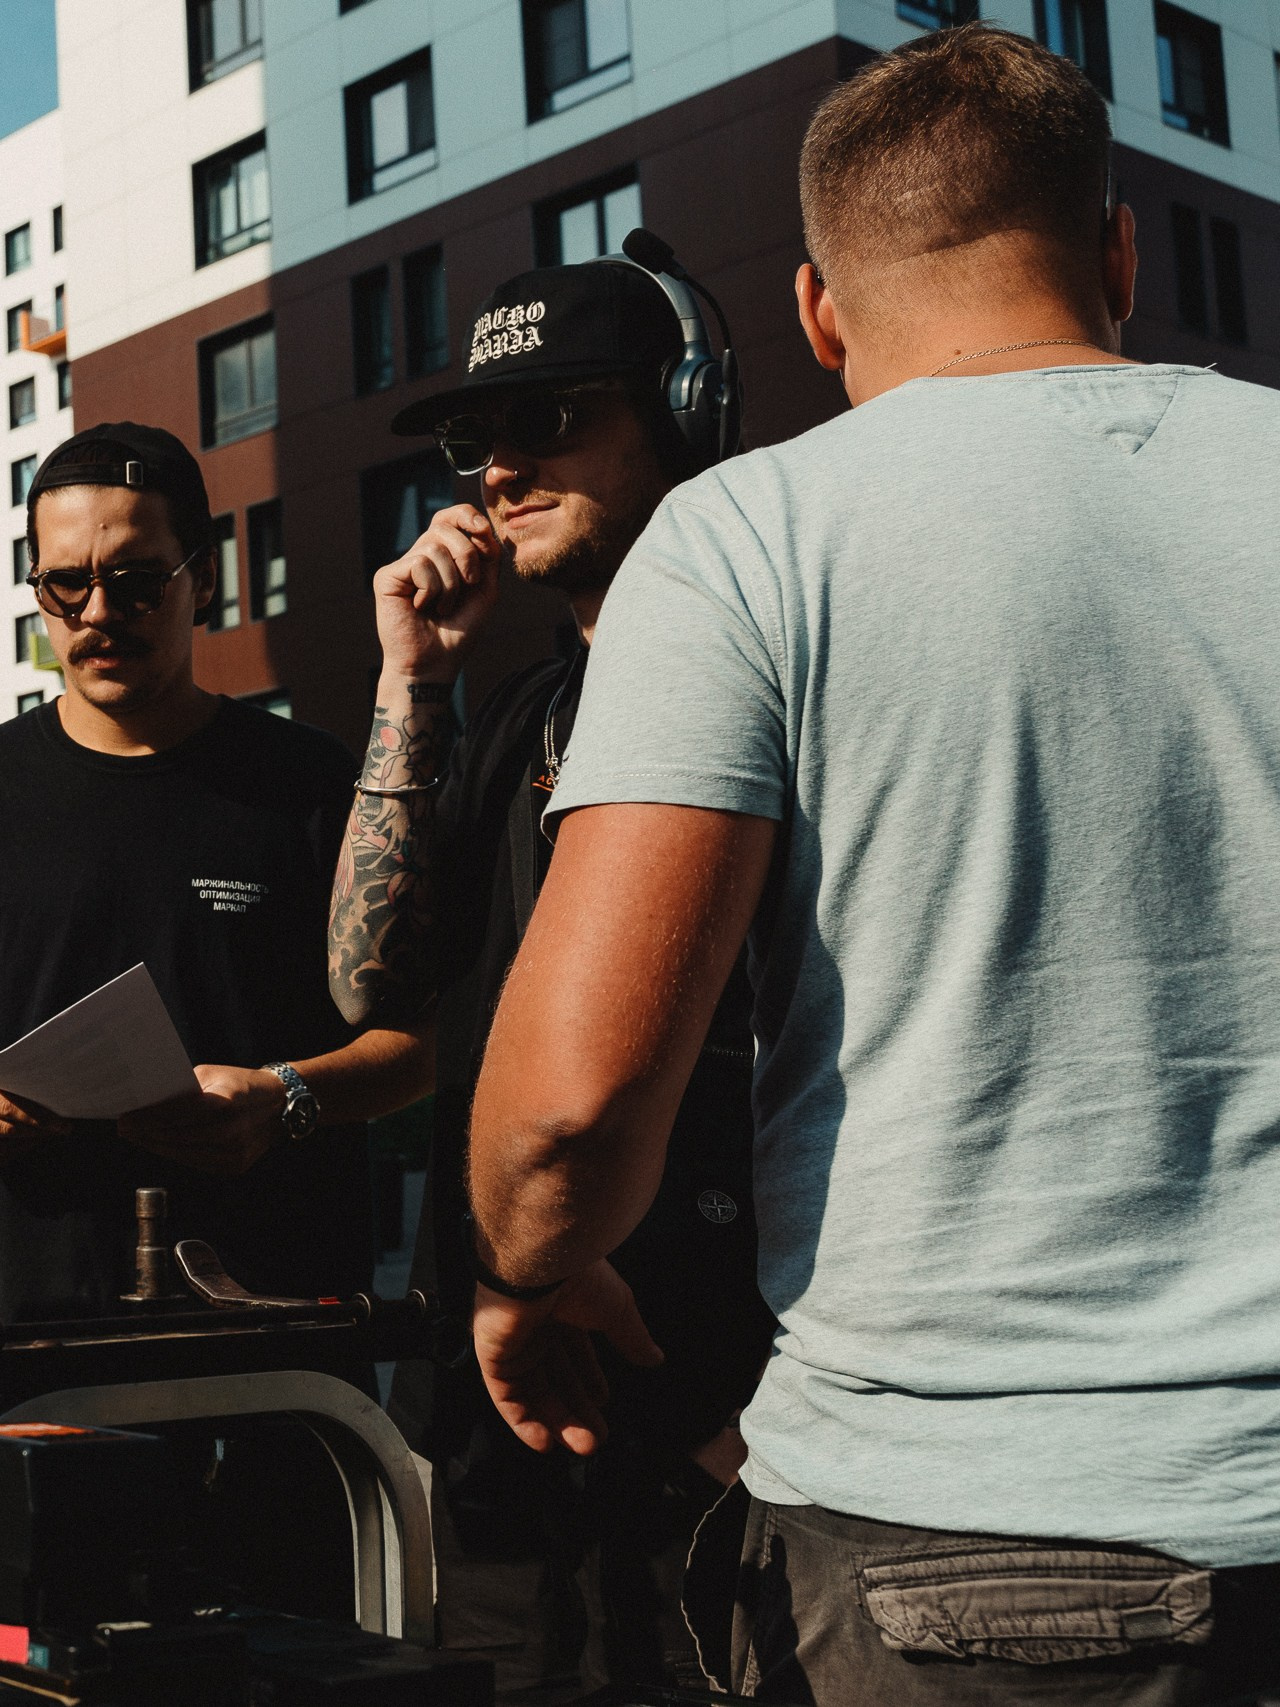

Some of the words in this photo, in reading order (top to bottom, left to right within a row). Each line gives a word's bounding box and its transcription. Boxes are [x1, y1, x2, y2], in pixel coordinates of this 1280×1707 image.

[468, 326, 544, 374] MARIA
[199, 889, 261, 903] ОПТИМИЗАЦИЯ
[213, 901, 247, 913] МАРКАП
